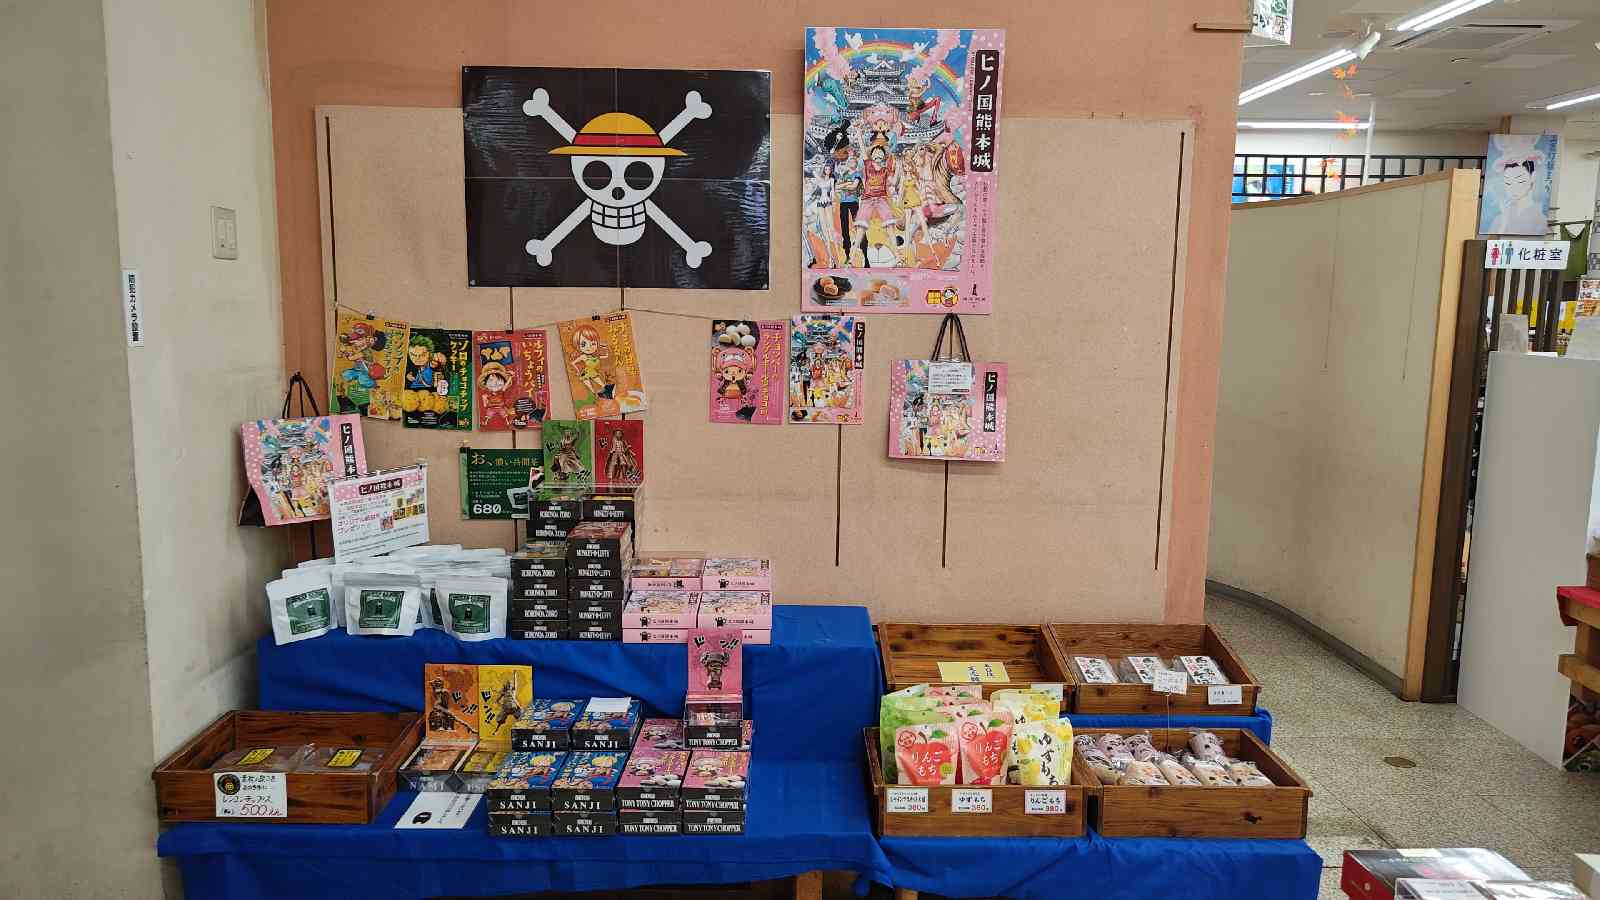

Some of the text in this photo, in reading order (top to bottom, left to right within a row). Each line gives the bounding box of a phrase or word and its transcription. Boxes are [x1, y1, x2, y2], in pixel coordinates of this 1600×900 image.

[972, 54, 994, 170] ヒノ国熊本城
[1517, 247, 1563, 262] 化粧室
[984, 373, 997, 431] ヒノ国熊本城
[473, 503, 502, 514] 680
[522, 740, 556, 748] SANJI
[584, 740, 618, 748] SANJI
[975, 742, 1001, 753] りんご
[911, 750, 942, 763] りんご
[983, 752, 999, 766] もち
[918, 763, 937, 776] もち
[500, 801, 536, 809] SANJI
[564, 801, 600, 810] SANJI
[502, 825, 538, 834] SANJI
[566, 824, 604, 834] SANJI
